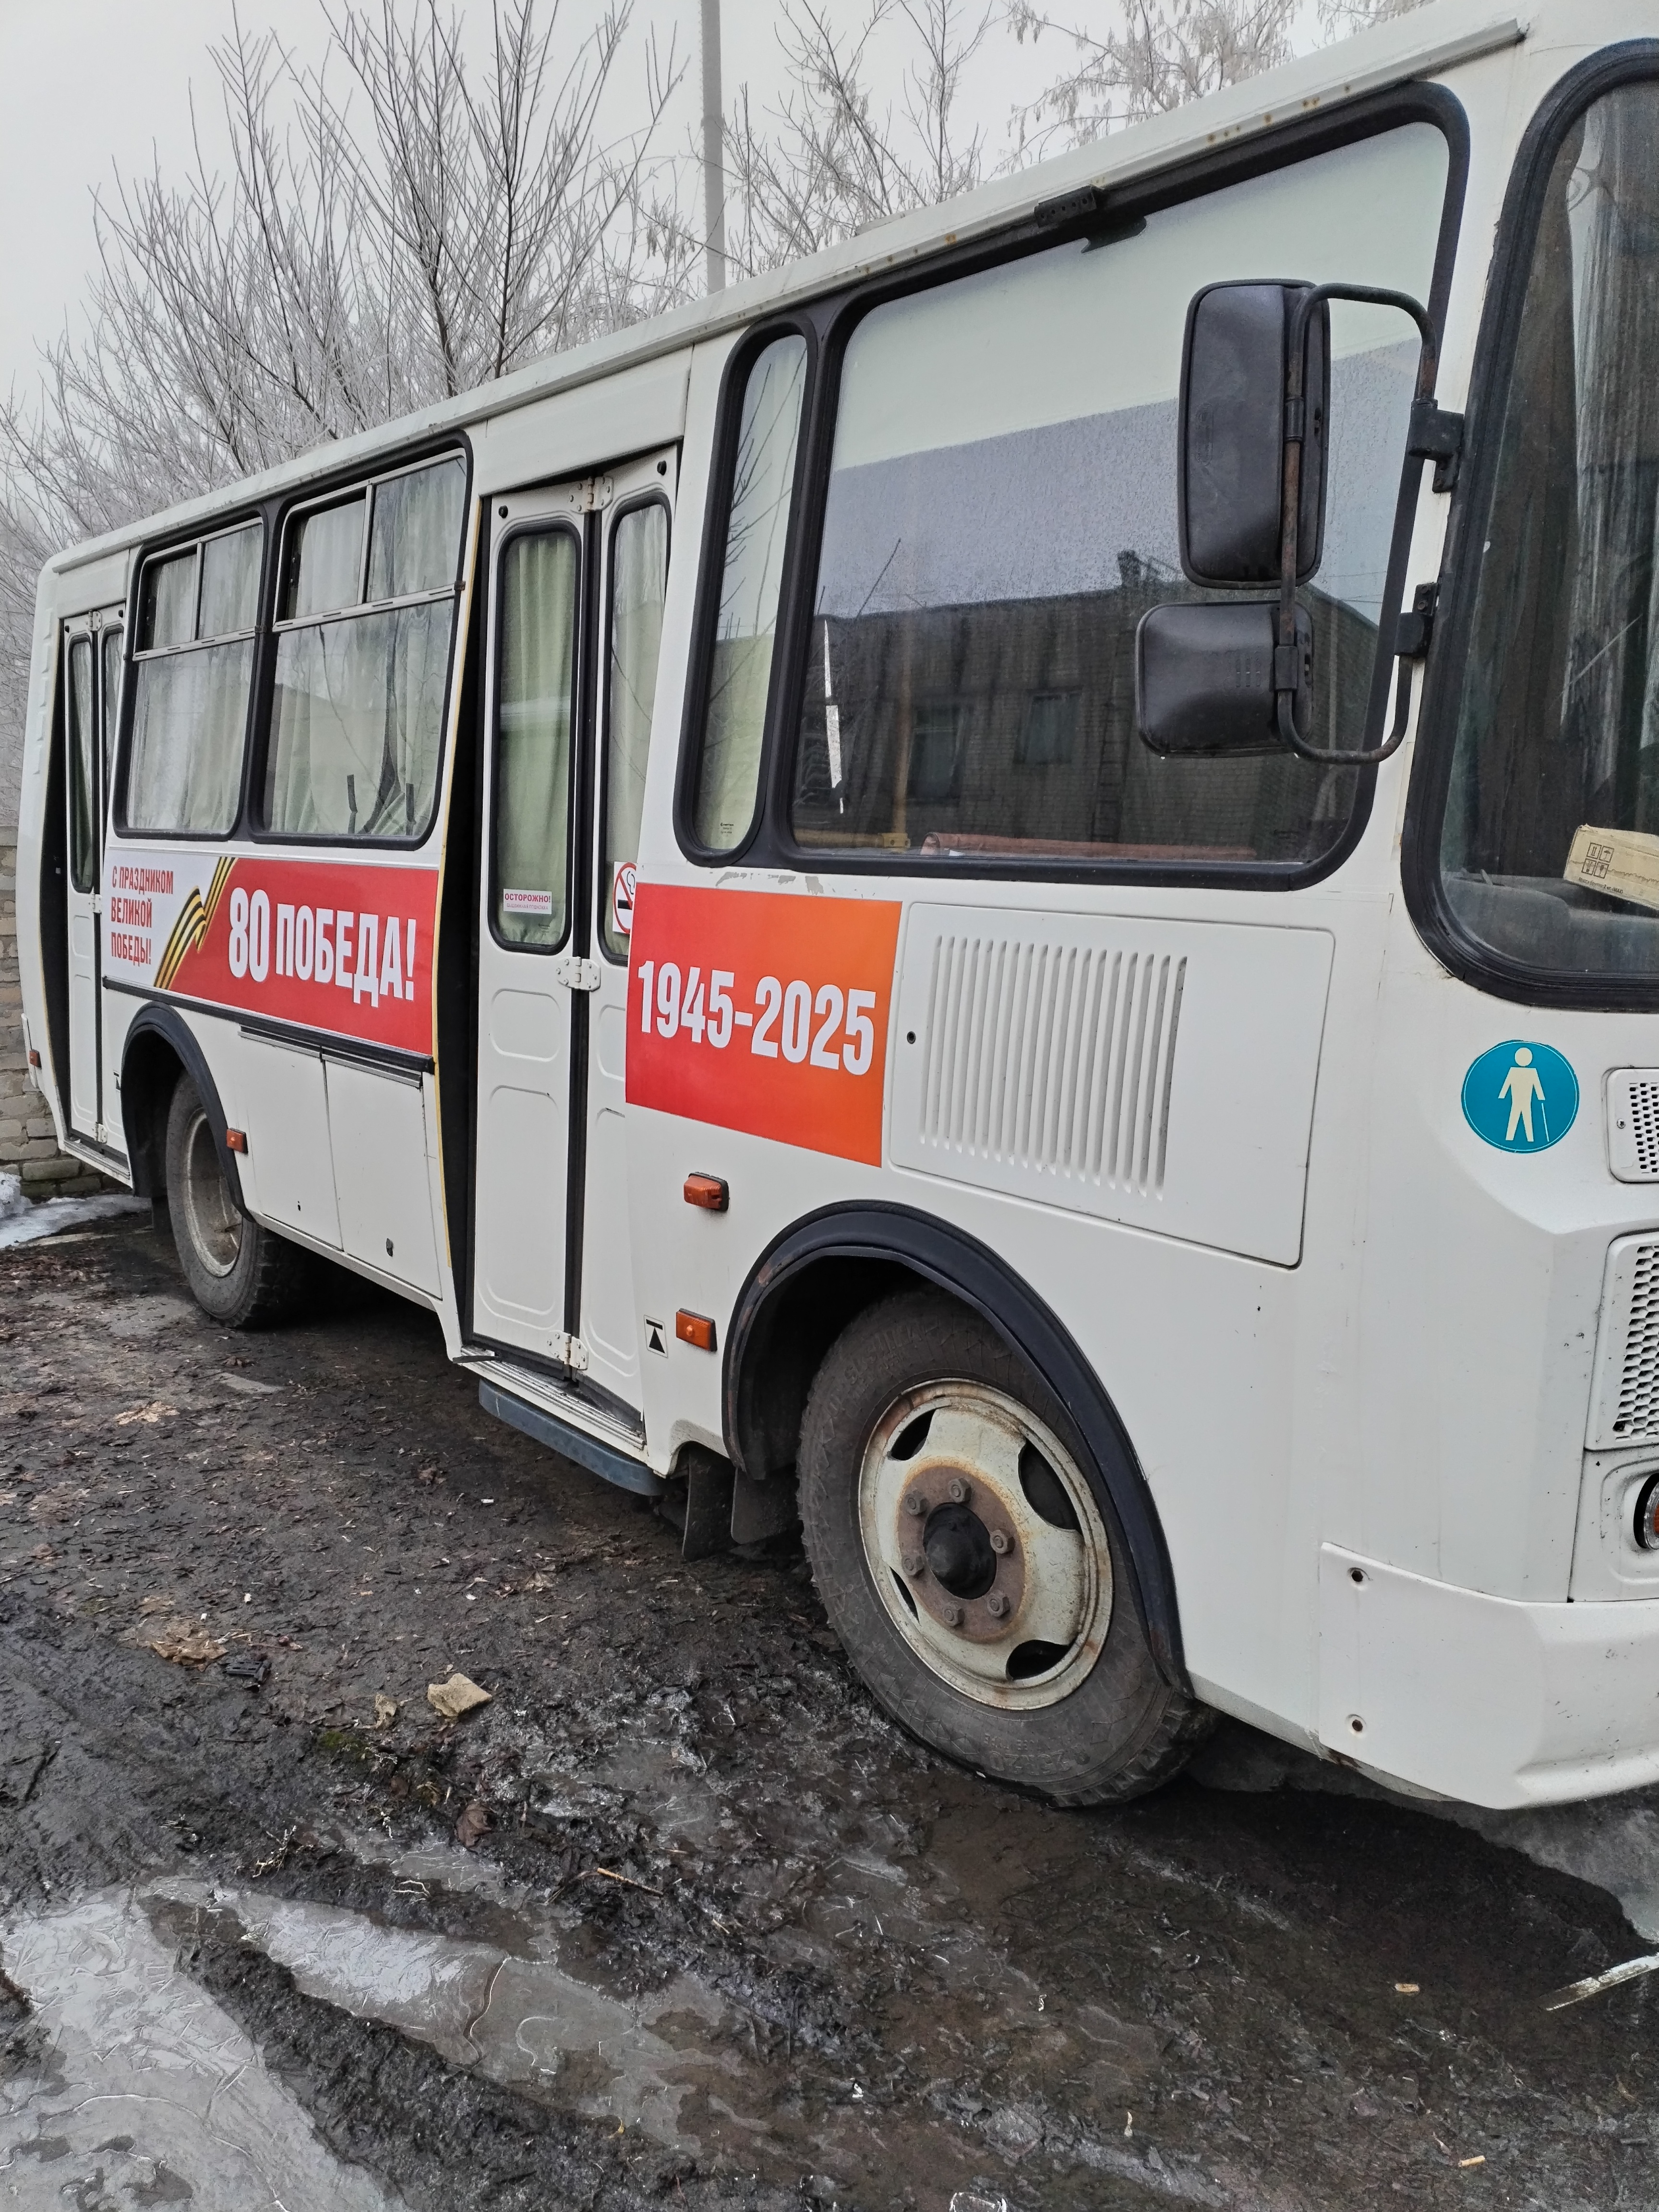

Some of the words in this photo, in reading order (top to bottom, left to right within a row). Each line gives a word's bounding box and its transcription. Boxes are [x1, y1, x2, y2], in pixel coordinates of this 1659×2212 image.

[112, 866, 117, 888] С
[119, 866, 174, 895] ПРАЗДНИКОМ
[111, 896, 152, 928] ВЕЛИКОЙ
[505, 893, 551, 903] ОСТОРОЖНО!
[111, 931, 151, 967] ПОБЕДЫ!
[228, 887, 270, 982] 80
[276, 903, 417, 1008] ПОБЕДА!
[637, 960, 877, 1076] 1945-2025
